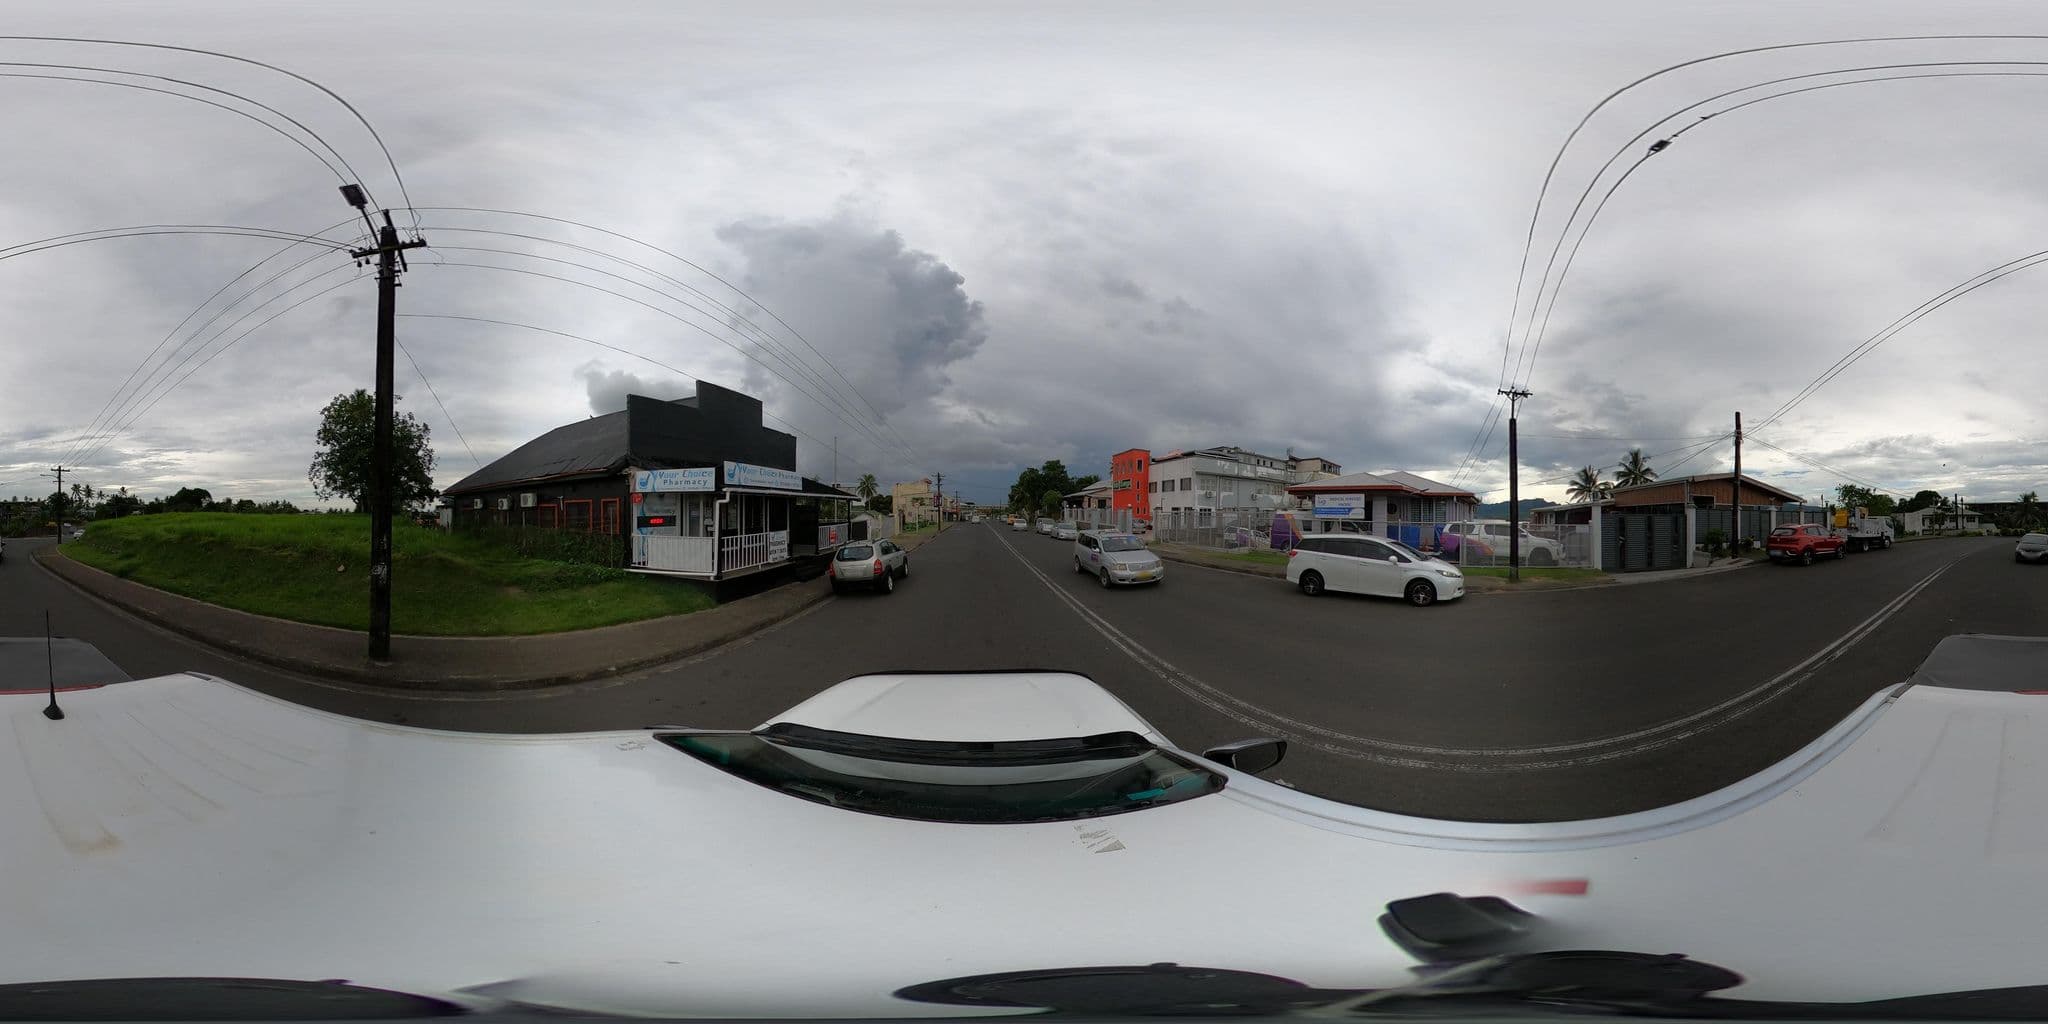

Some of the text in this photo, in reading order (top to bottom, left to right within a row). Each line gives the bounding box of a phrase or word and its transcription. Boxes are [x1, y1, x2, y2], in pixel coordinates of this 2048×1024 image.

[658, 469, 713, 479] Your Choice
[663, 479, 708, 487] Pharmacy
